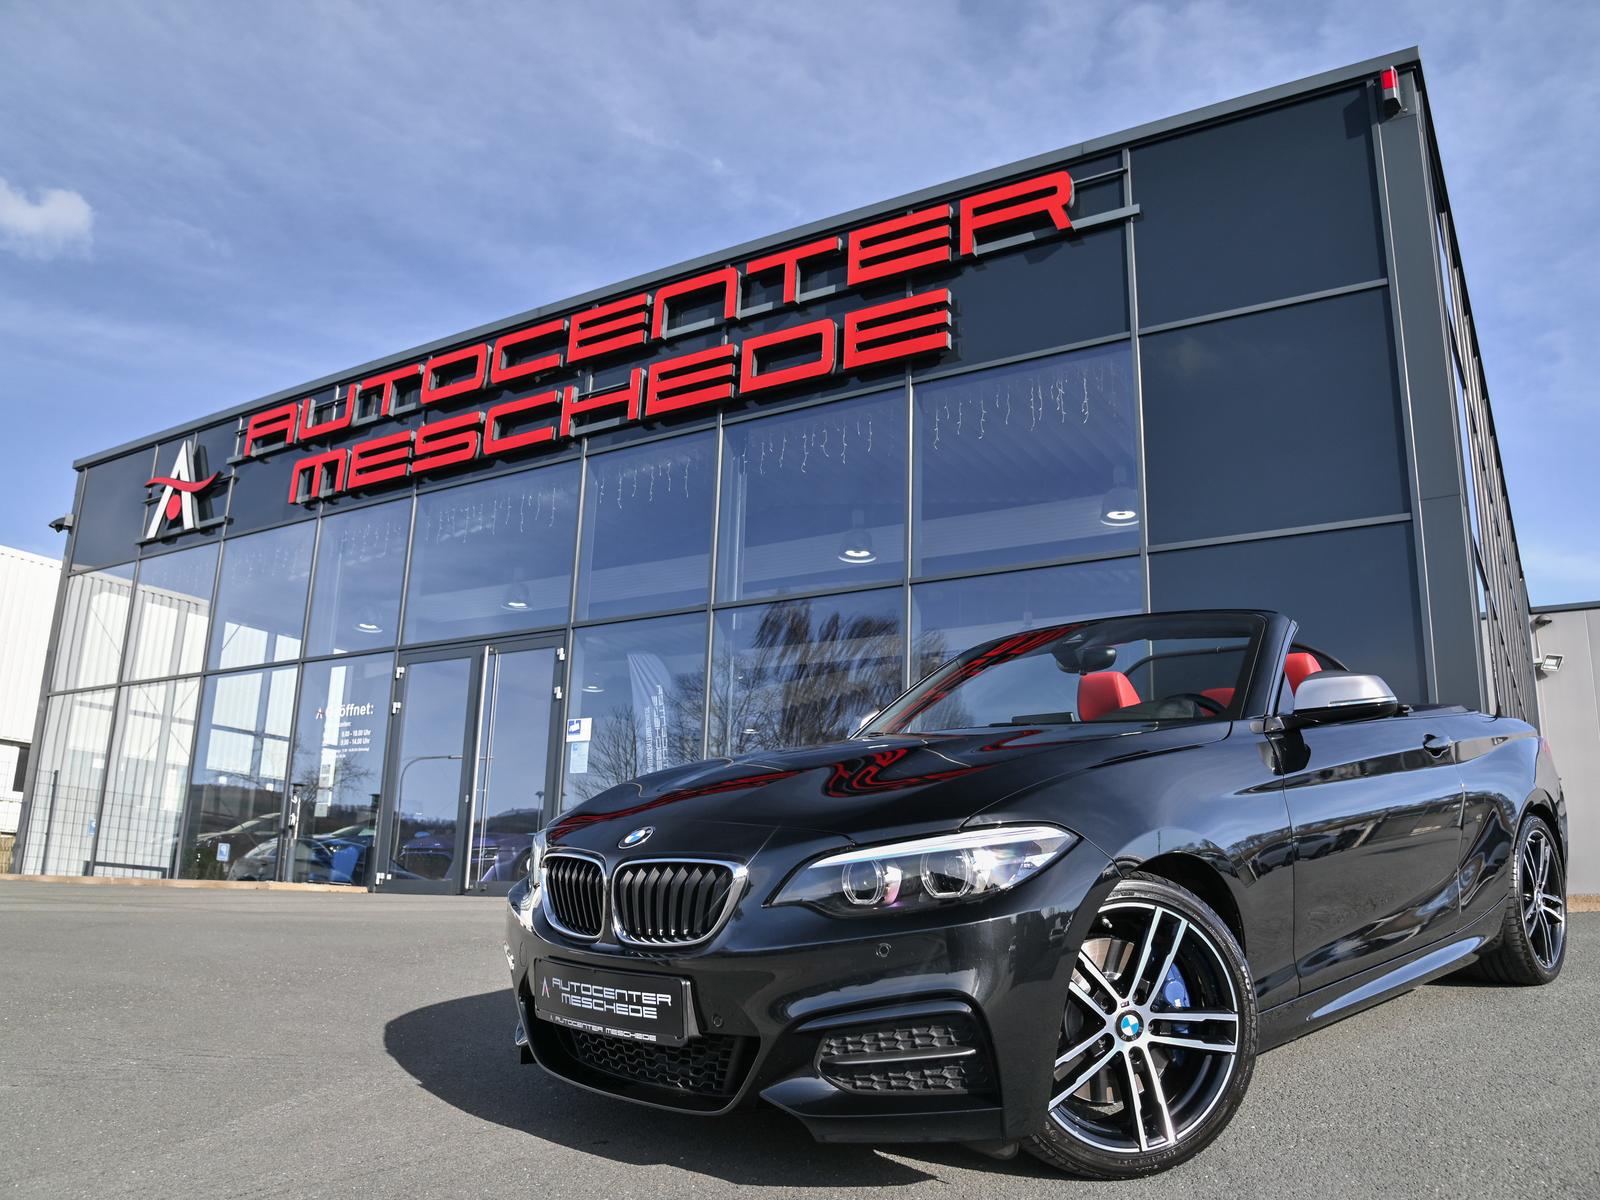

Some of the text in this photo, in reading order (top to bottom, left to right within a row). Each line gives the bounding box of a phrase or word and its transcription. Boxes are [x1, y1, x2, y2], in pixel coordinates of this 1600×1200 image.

[244, 171, 1074, 456] AUTOCENTER
[288, 288, 951, 504] MESCHEDE
[552, 977, 672, 1006] AUTOCENTER
[561, 993, 658, 1019] MESCHEDE
[555, 1015, 657, 1042] AUTOCENTER MESCHEDE
